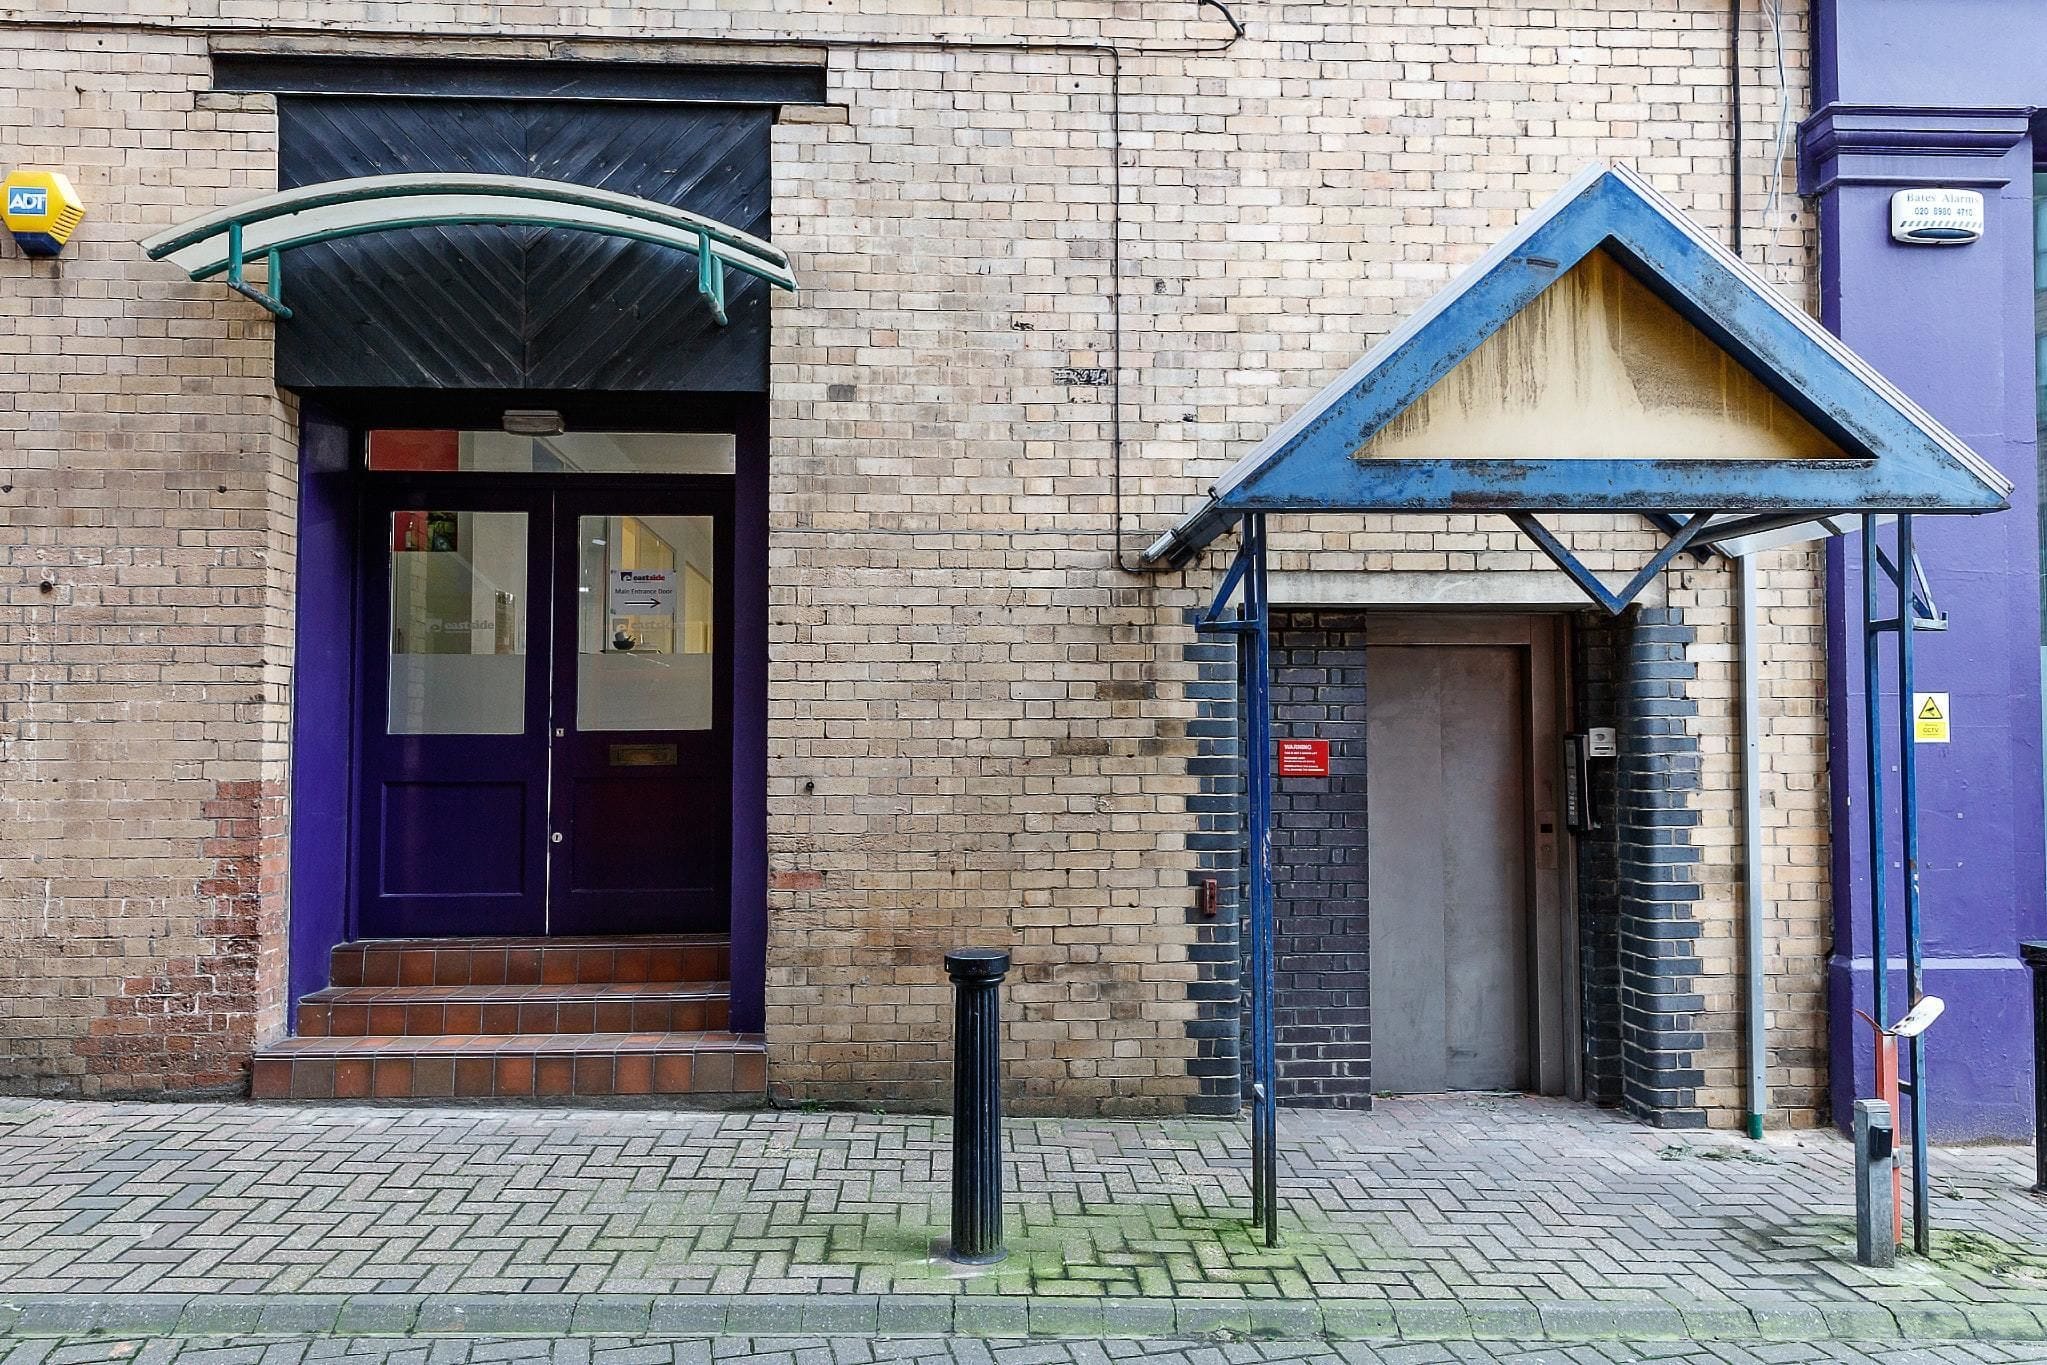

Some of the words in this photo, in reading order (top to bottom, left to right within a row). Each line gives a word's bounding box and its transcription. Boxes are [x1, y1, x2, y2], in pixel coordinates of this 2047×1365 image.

[10, 193, 46, 209] ADT
[1907, 193, 1936, 202] Bates
[1943, 194, 1979, 204] Alarms
